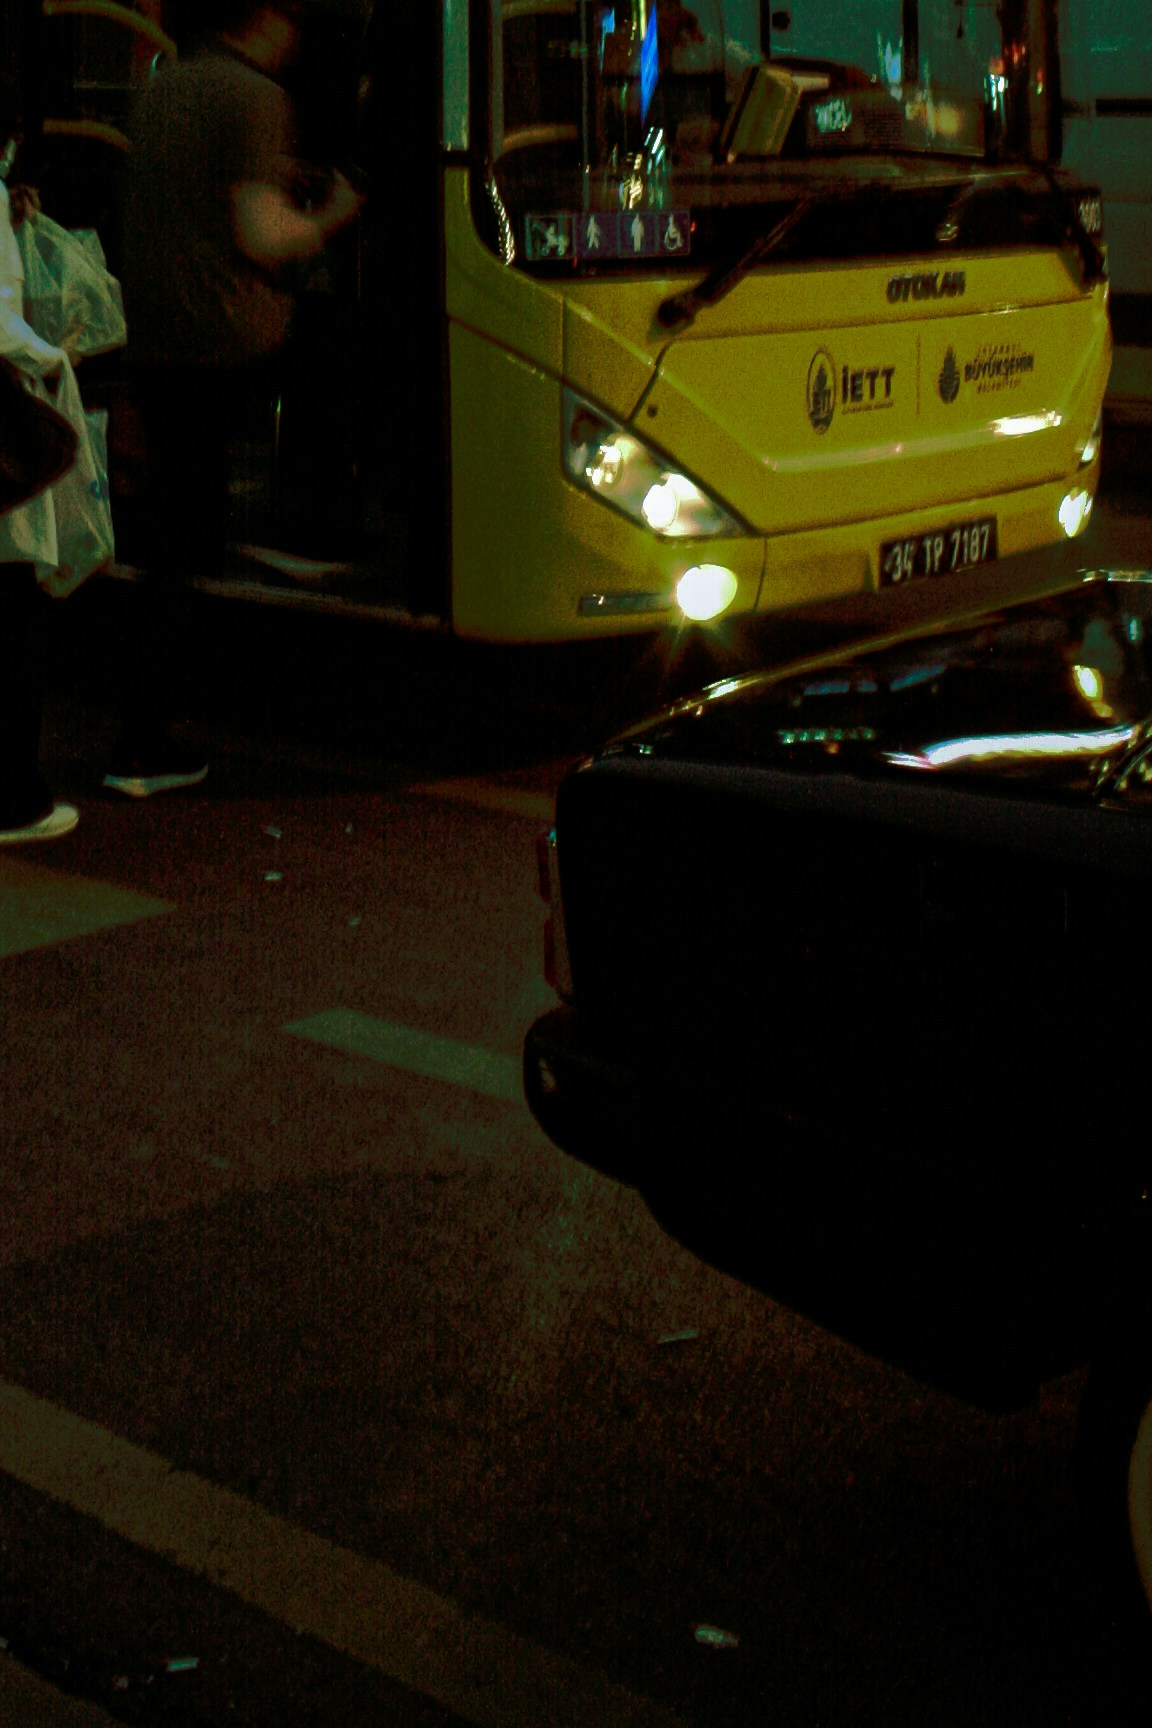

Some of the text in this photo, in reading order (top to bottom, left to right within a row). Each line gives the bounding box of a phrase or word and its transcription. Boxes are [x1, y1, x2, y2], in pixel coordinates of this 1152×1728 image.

[841, 365, 896, 404] İETT
[884, 522, 992, 582] 34 TP 7187
